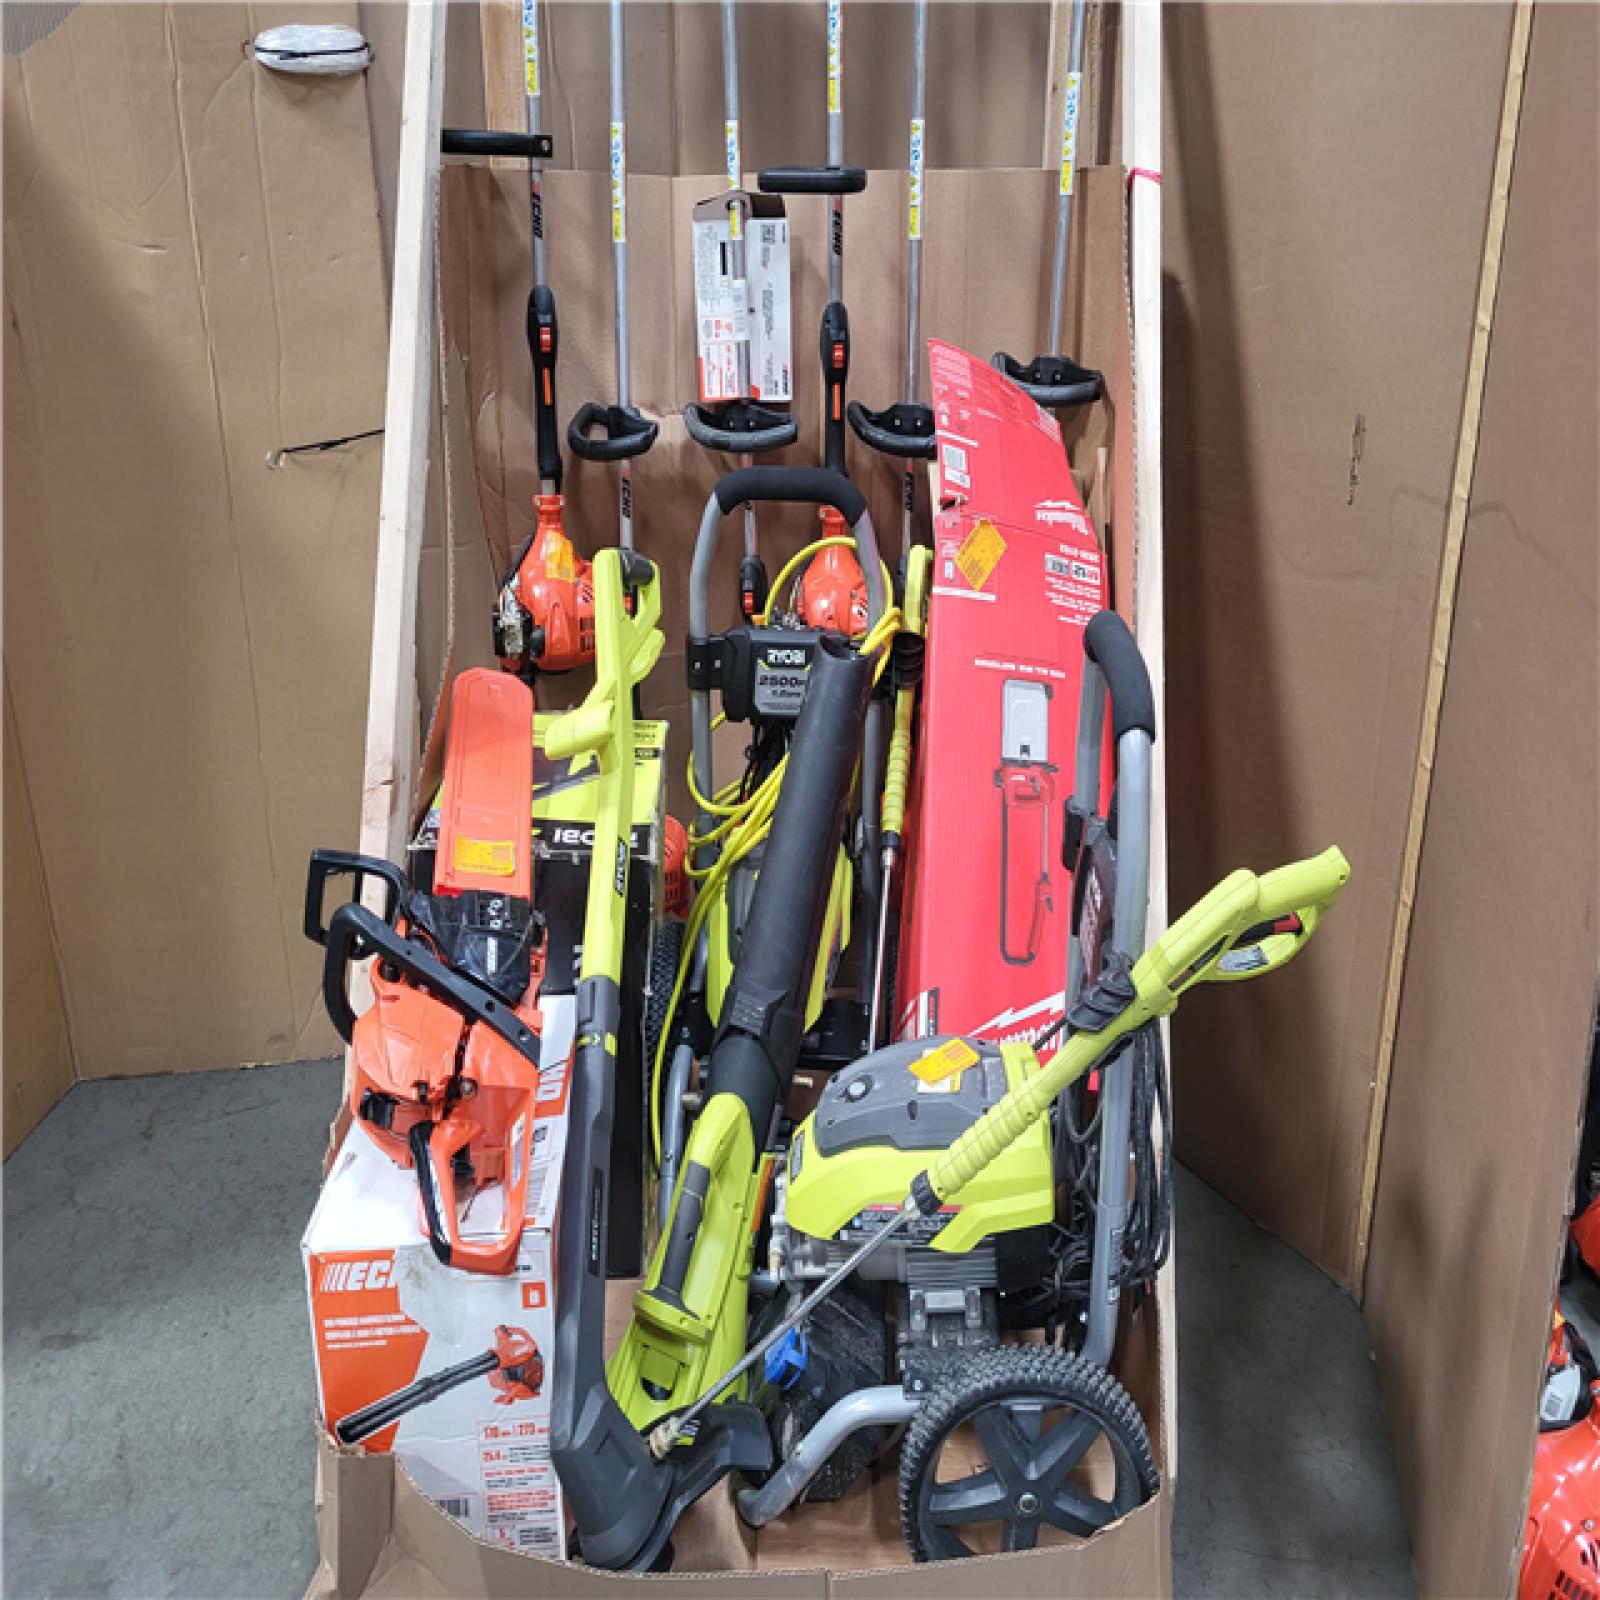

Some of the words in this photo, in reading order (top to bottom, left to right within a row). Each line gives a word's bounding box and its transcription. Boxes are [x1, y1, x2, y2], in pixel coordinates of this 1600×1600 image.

[532, 192, 544, 241] ECHO
[832, 209, 843, 257] ECHO
[622, 477, 632, 519] ECHO
[767, 649, 806, 666] RYOBI
[759, 674, 798, 688] 2500
